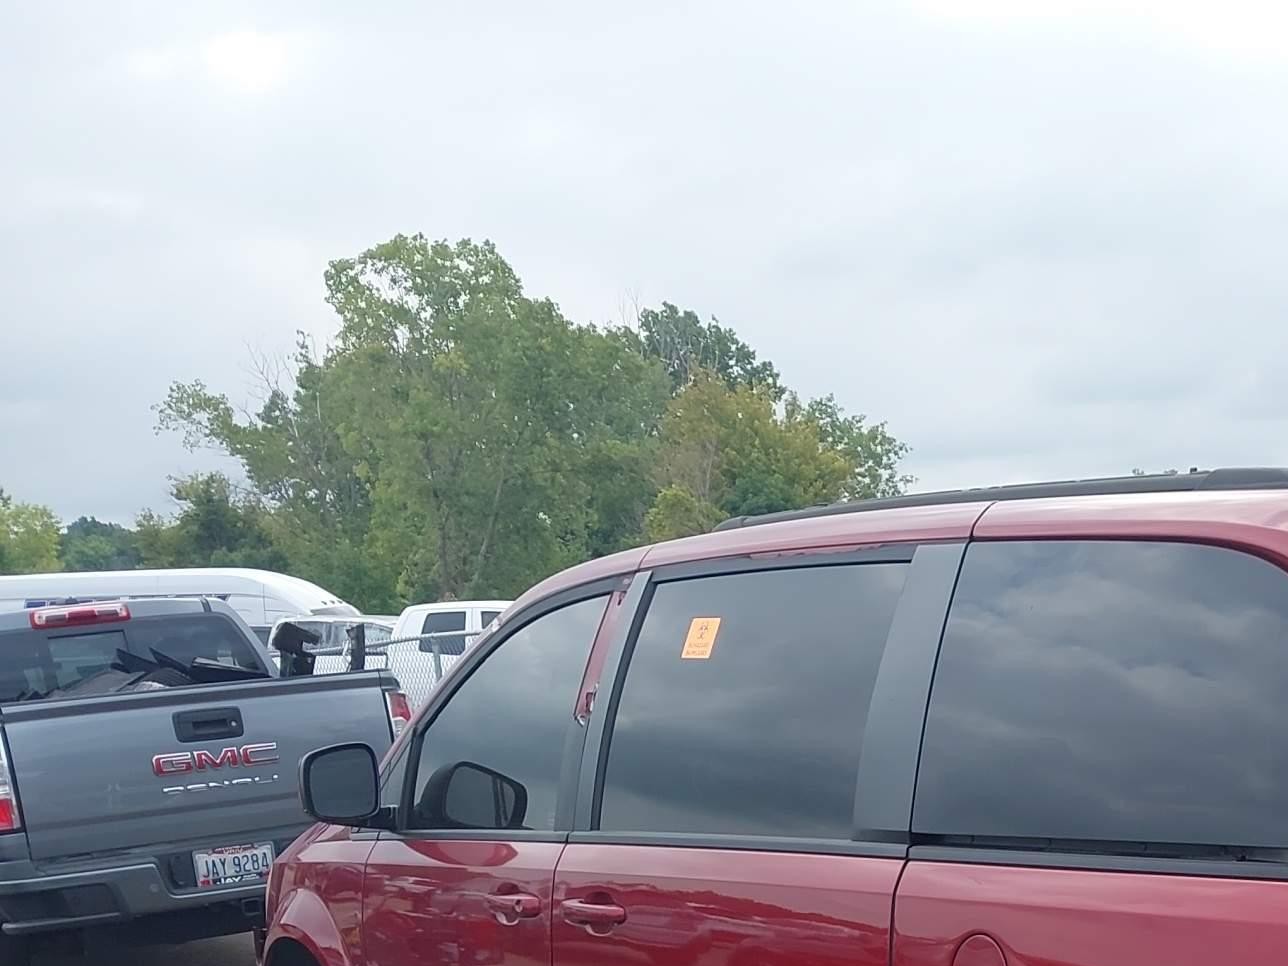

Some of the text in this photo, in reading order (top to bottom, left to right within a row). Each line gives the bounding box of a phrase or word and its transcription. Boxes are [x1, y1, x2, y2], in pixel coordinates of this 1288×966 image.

[152, 742, 280, 776] GMC
[203, 852, 269, 878] JAY 9284
